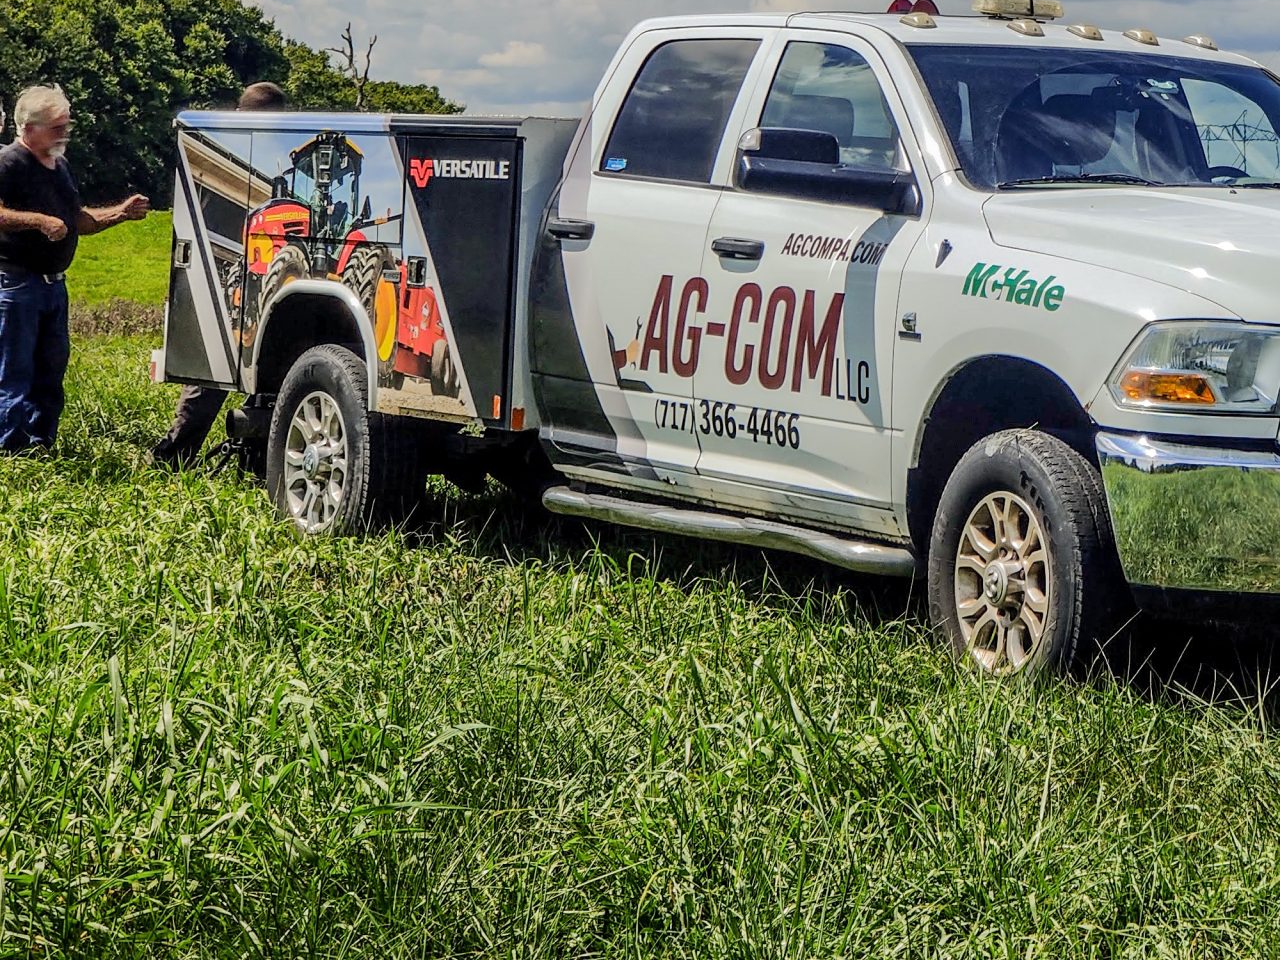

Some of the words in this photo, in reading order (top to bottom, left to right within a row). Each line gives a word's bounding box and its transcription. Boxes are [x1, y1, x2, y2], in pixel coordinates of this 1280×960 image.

[433, 159, 510, 179] VERSATILE
[781, 233, 889, 265] AGCOMPA.COM
[961, 262, 1065, 311] McHale
[639, 274, 846, 397] AG-COM
[835, 358, 870, 404] LLC
[655, 399, 695, 435] (717)
[699, 399, 800, 450] 366-4466
